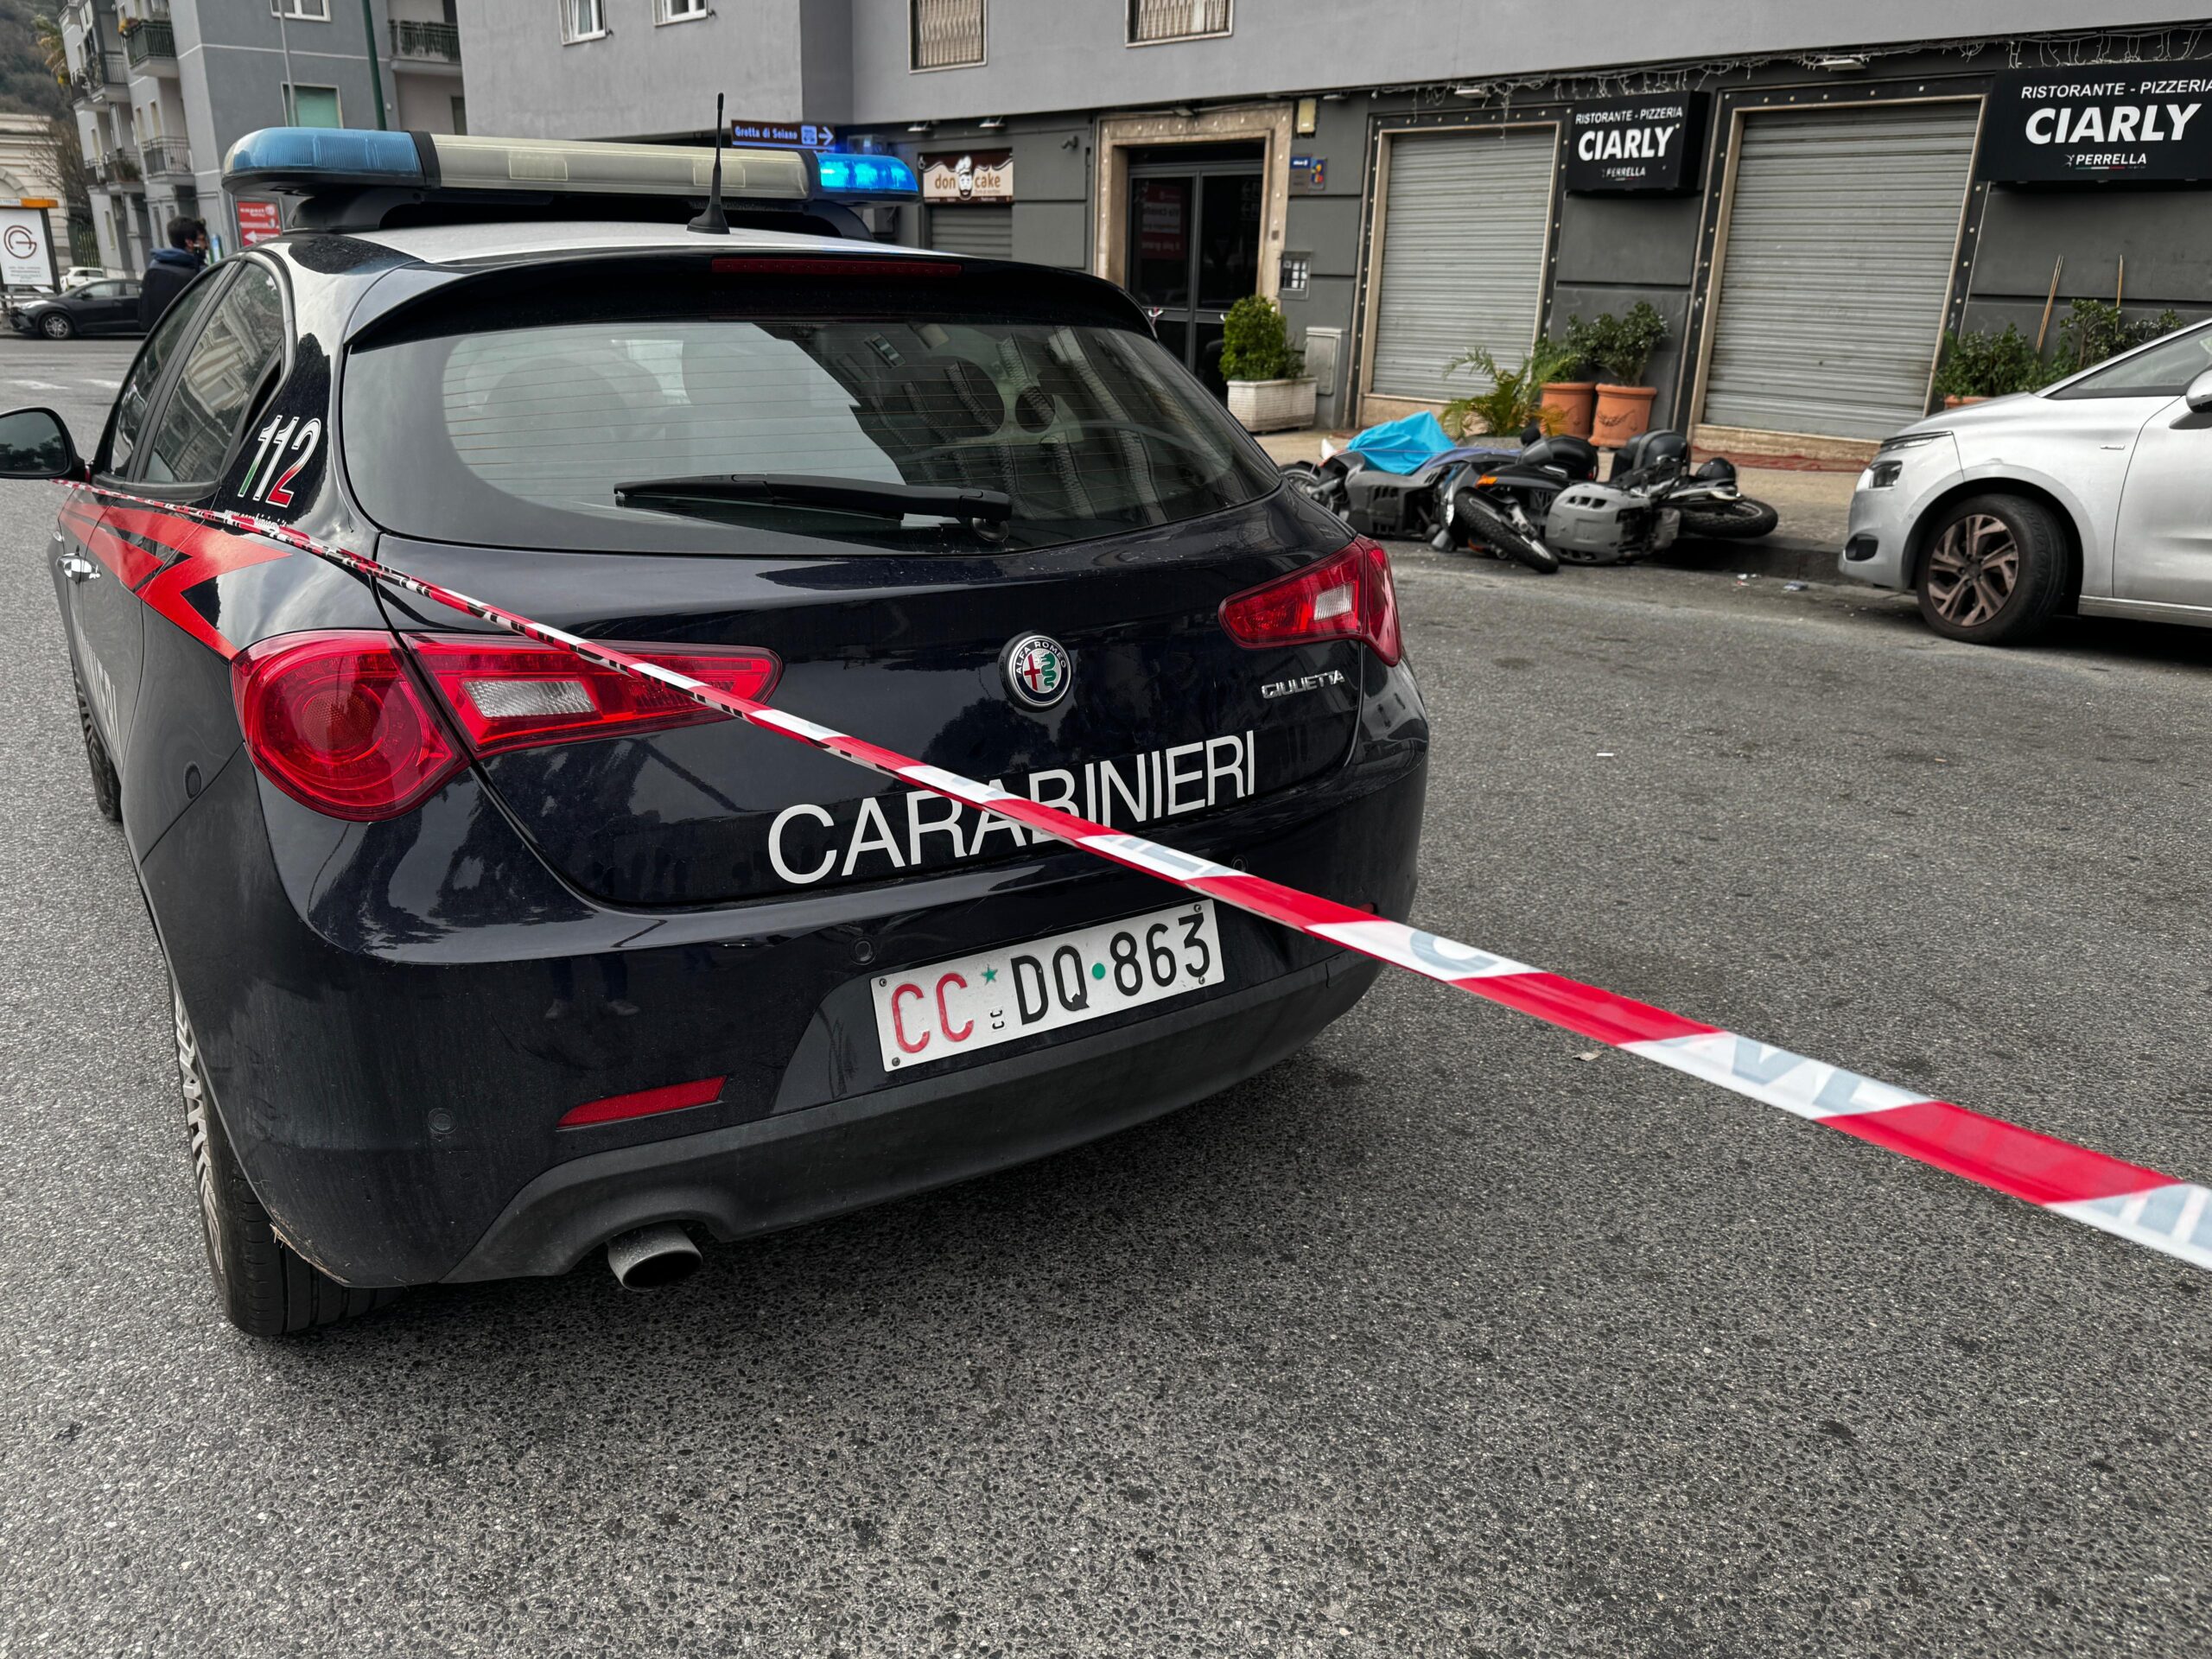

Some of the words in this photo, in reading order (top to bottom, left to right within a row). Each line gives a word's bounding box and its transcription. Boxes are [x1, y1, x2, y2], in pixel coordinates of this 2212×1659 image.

[2021, 82, 2126, 99] RISTORANTE
[1575, 110, 1633, 124] RISTORANTE
[1640, 106, 1683, 120] PIZZERIA
[2025, 103, 2202, 144] CIARLY
[734, 125, 760, 138] Grotta
[762, 127, 770, 138] di
[1578, 126, 1675, 162] CIARLY
[2075, 153, 2147, 165] PERRELLA
[935, 174, 957, 189] don
[974, 173, 1001, 188] cake
[238, 415, 321, 508] 112
[1015, 646, 1032, 675] ALFA
[1033, 641, 1066, 668] ROMEO
[1261, 670, 1345, 699] GIULIETTA
[768, 730, 1255, 885] CARABINIERI
[890, 971, 975, 1054] CC
[1010, 944, 1090, 1027] DQ
[1109, 912, 1211, 997] 863
